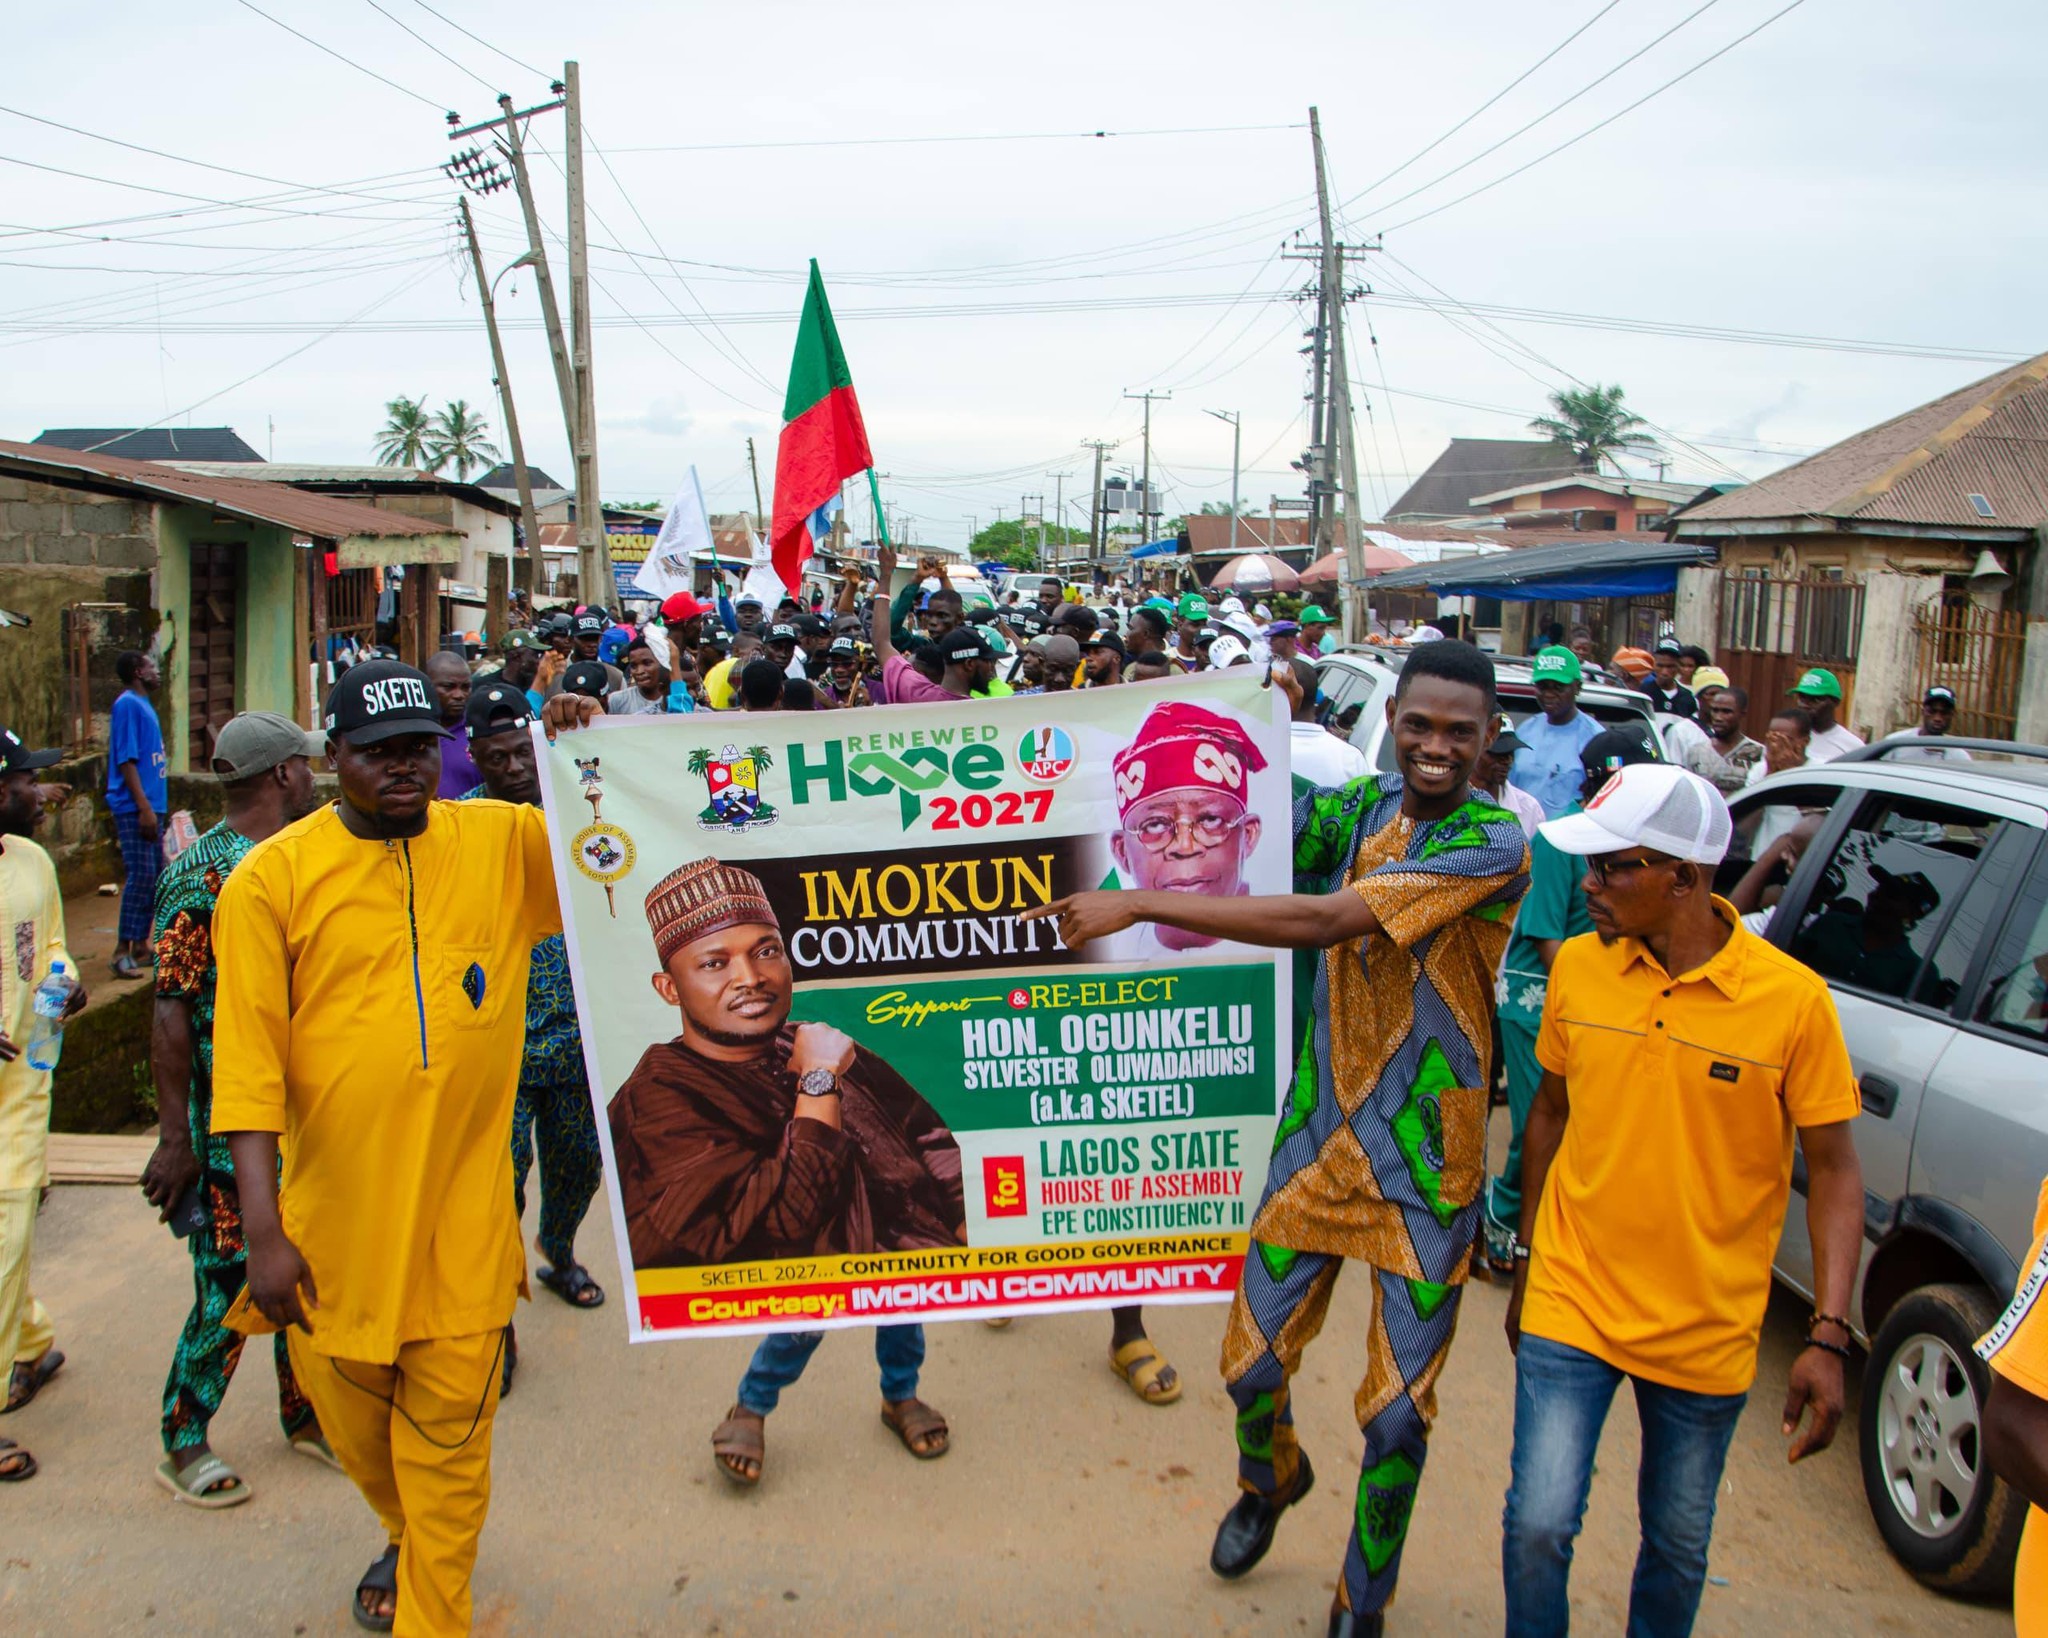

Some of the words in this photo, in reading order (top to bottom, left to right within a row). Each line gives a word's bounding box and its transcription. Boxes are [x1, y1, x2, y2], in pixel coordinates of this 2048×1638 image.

[606, 534, 657, 549] OKU
[362, 677, 431, 715] SKETEL
[847, 724, 999, 752] RENEWED
[786, 739, 1005, 832] Hope
[1029, 760, 1065, 777] APC
[928, 789, 1055, 831] 2027
[576, 826, 599, 845] HOUSE
[617, 831, 635, 868] ASSEMBLY
[573, 849, 585, 870] STATE
[587, 870, 614, 881] LAGOS
[799, 854, 1055, 921] IMOKUN
[790, 913, 1068, 968] COMMUNITY
[865, 990, 1003, 1027] Support
[1031, 976, 1178, 1009] RE-ELECT
[961, 1016, 1049, 1059] HON.
[1060, 1004, 1253, 1054] OGUNKELU
[963, 1056, 1079, 1090] SYLVESTER
[1090, 1046, 1255, 1085] OLUWADAHUNSI
[1029, 1089, 1094, 1126] (a.k.a
[1100, 1083, 1196, 1120] SKETEL)
[1040, 1136, 1139, 1178] LAGOS
[1151, 1129, 1240, 1172] STATE
[993, 1168, 1019, 1208] for
[1041, 1179, 1104, 1206] HOUSE
[1111, 1177, 1135, 1203] OF
[1141, 1171, 1244, 1199] ASSEMBLY
[1042, 1209, 1077, 1236] EPE
[1083, 1201, 1225, 1232] CONSTITUENCY
[1231, 1201, 1244, 1226] II
[701, 1267, 768, 1287] SKETEL
[775, 1264, 834, 1281] 2027...
[841, 1253, 971, 1275] CONTINUITY
[977, 1251, 1018, 1268] FOR
[1025, 1246, 1085, 1263] GOOD
[1092, 1237, 1232, 1259] GOVERNANCE
[688, 1293, 847, 1321] Courtesy:
[851, 1277, 998, 1312] IMOKUN
[1002, 1262, 1228, 1300] COMMUNITY
